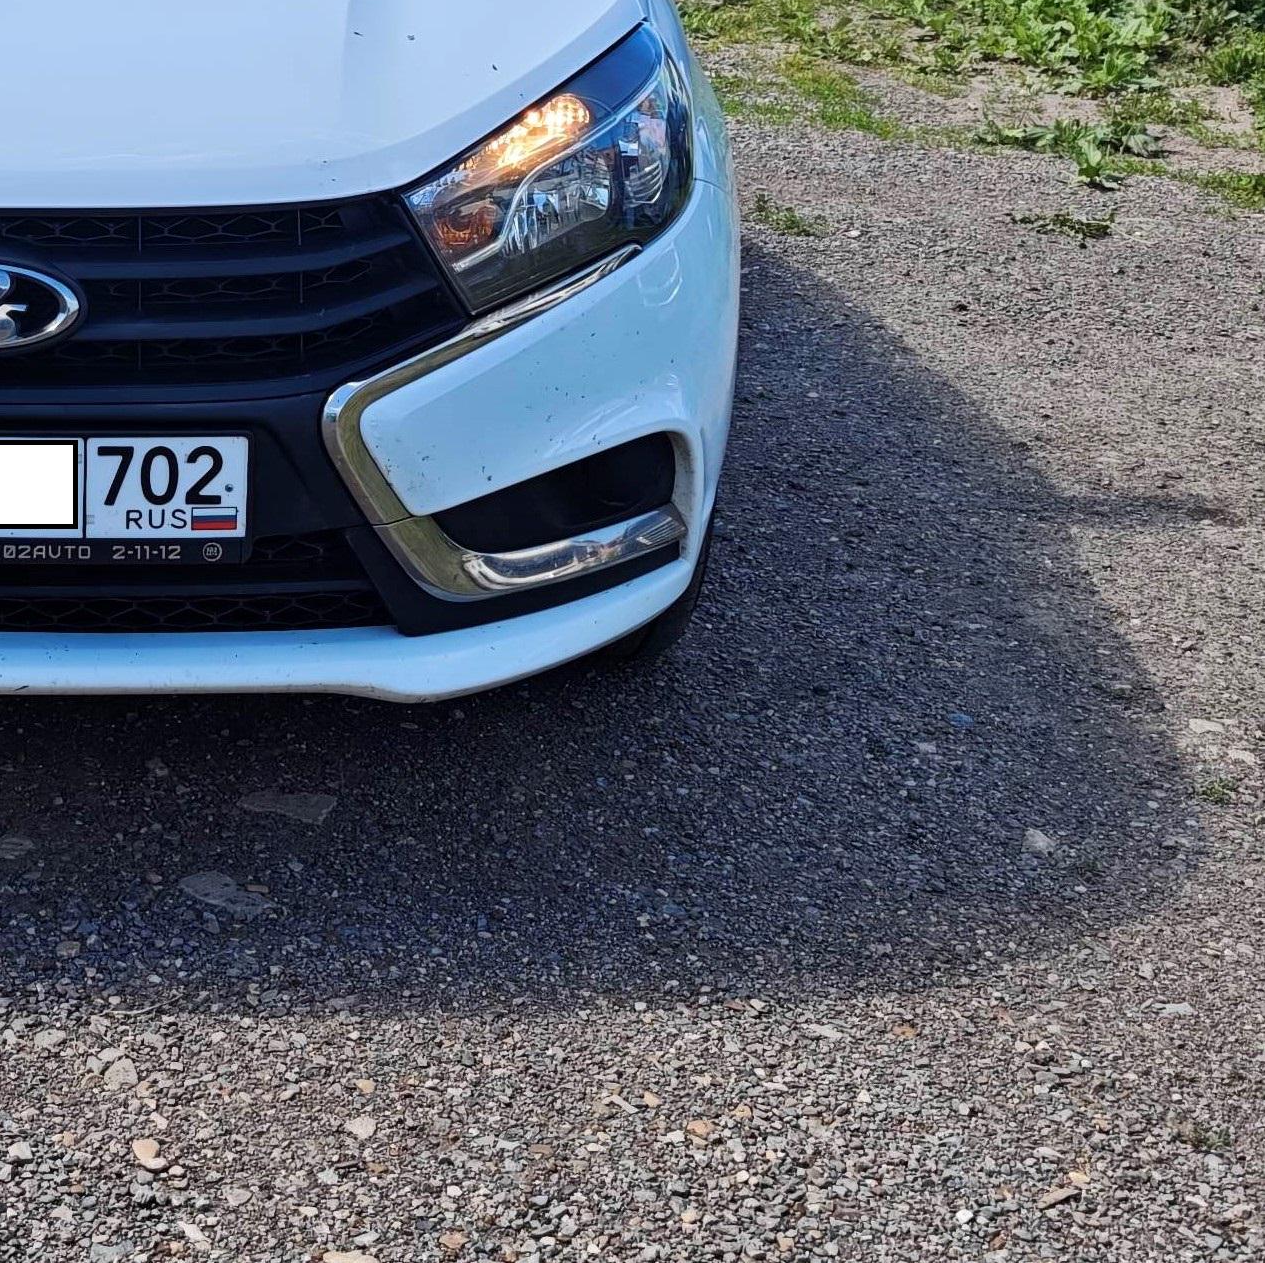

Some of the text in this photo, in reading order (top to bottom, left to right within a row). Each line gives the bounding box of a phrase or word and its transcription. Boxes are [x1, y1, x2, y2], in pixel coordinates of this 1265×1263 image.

[97, 445, 224, 506] 702
[125, 508, 188, 530] RUS
[112, 544, 182, 560] 2-11-12
